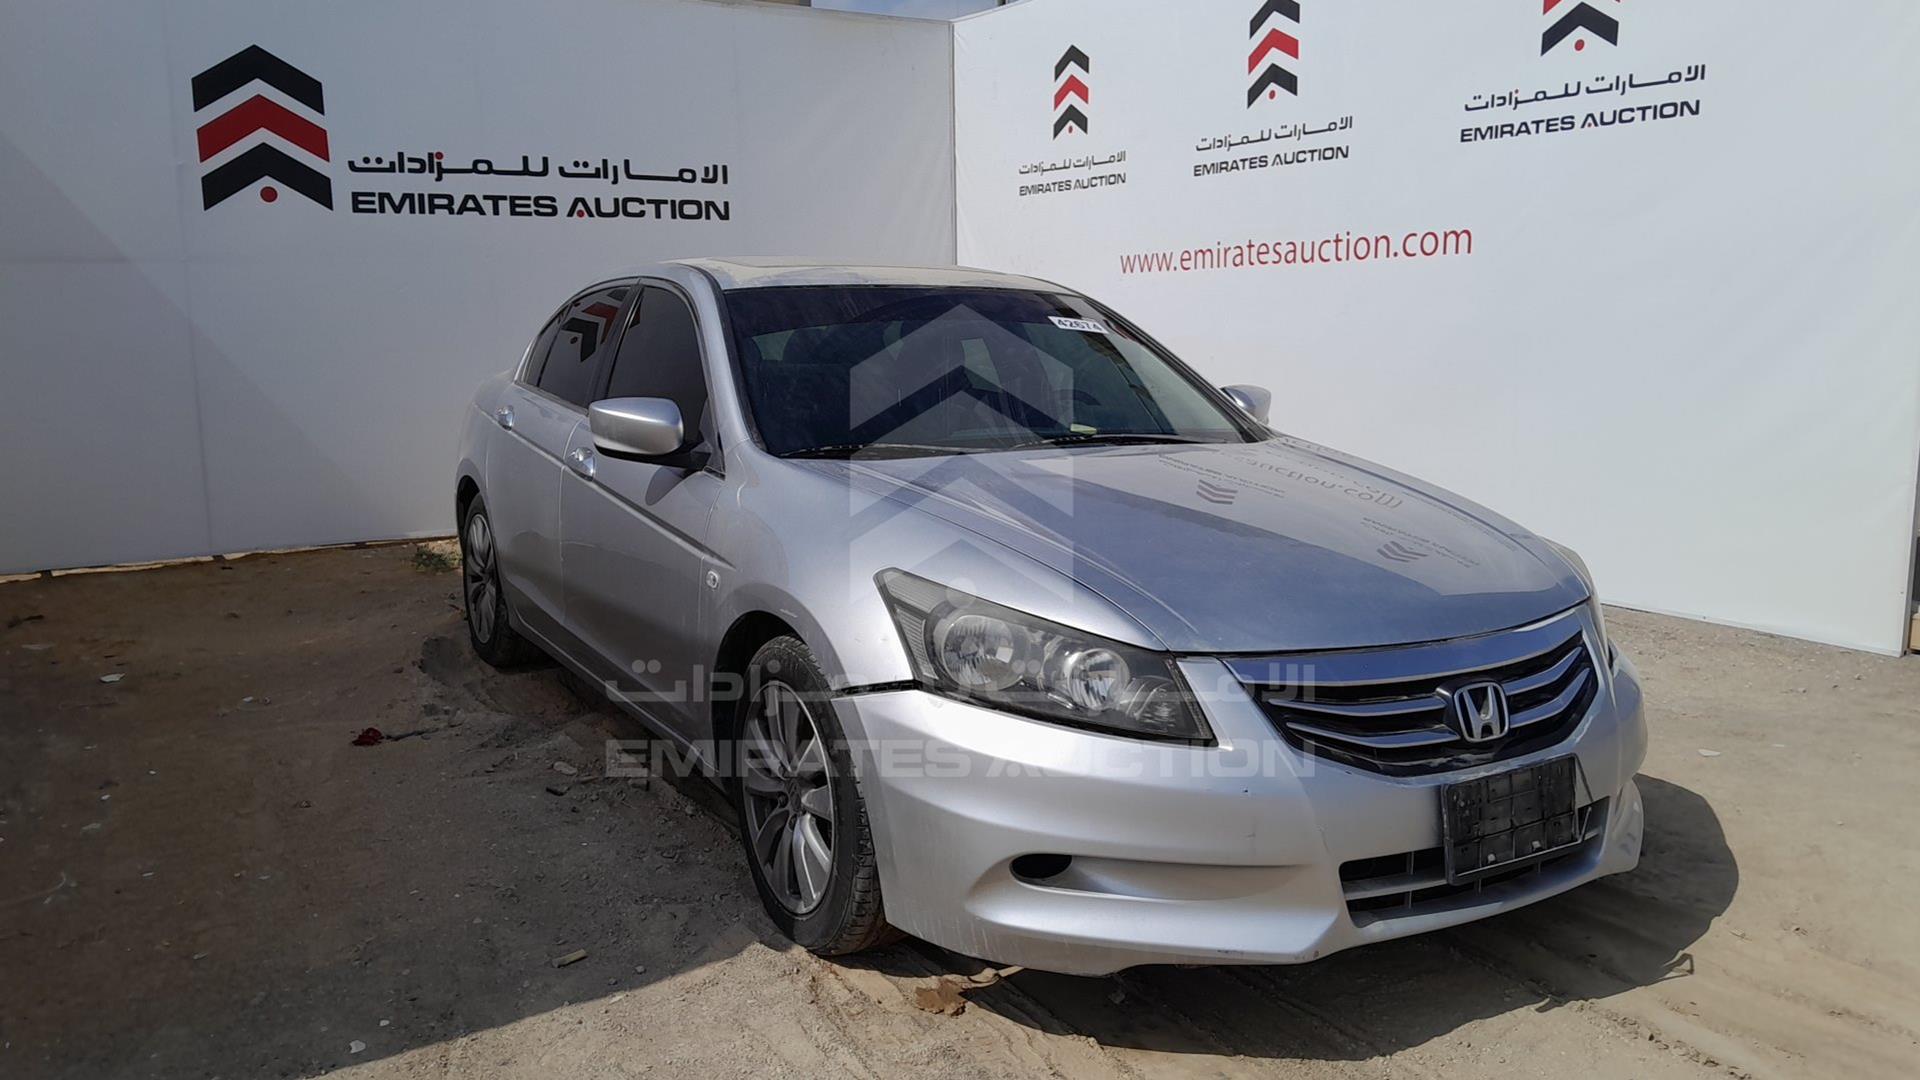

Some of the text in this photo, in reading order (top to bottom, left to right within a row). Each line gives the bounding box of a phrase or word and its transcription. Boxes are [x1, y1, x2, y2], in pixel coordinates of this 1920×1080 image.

[1464, 63, 1707, 111] الامارات للمزادات
[1460, 99, 1701, 142] EMIRATES AUCTION
[347, 152, 730, 185] الامارات للمزادات
[1193, 145, 1350, 177] EMIRATES AUCTION
[1018, 172, 1127, 196] EMIRATES AUCTION
[350, 191, 731, 221] EMIRATES AUCTION
[1119, 228, 1473, 274] www.emiratesauction.com
